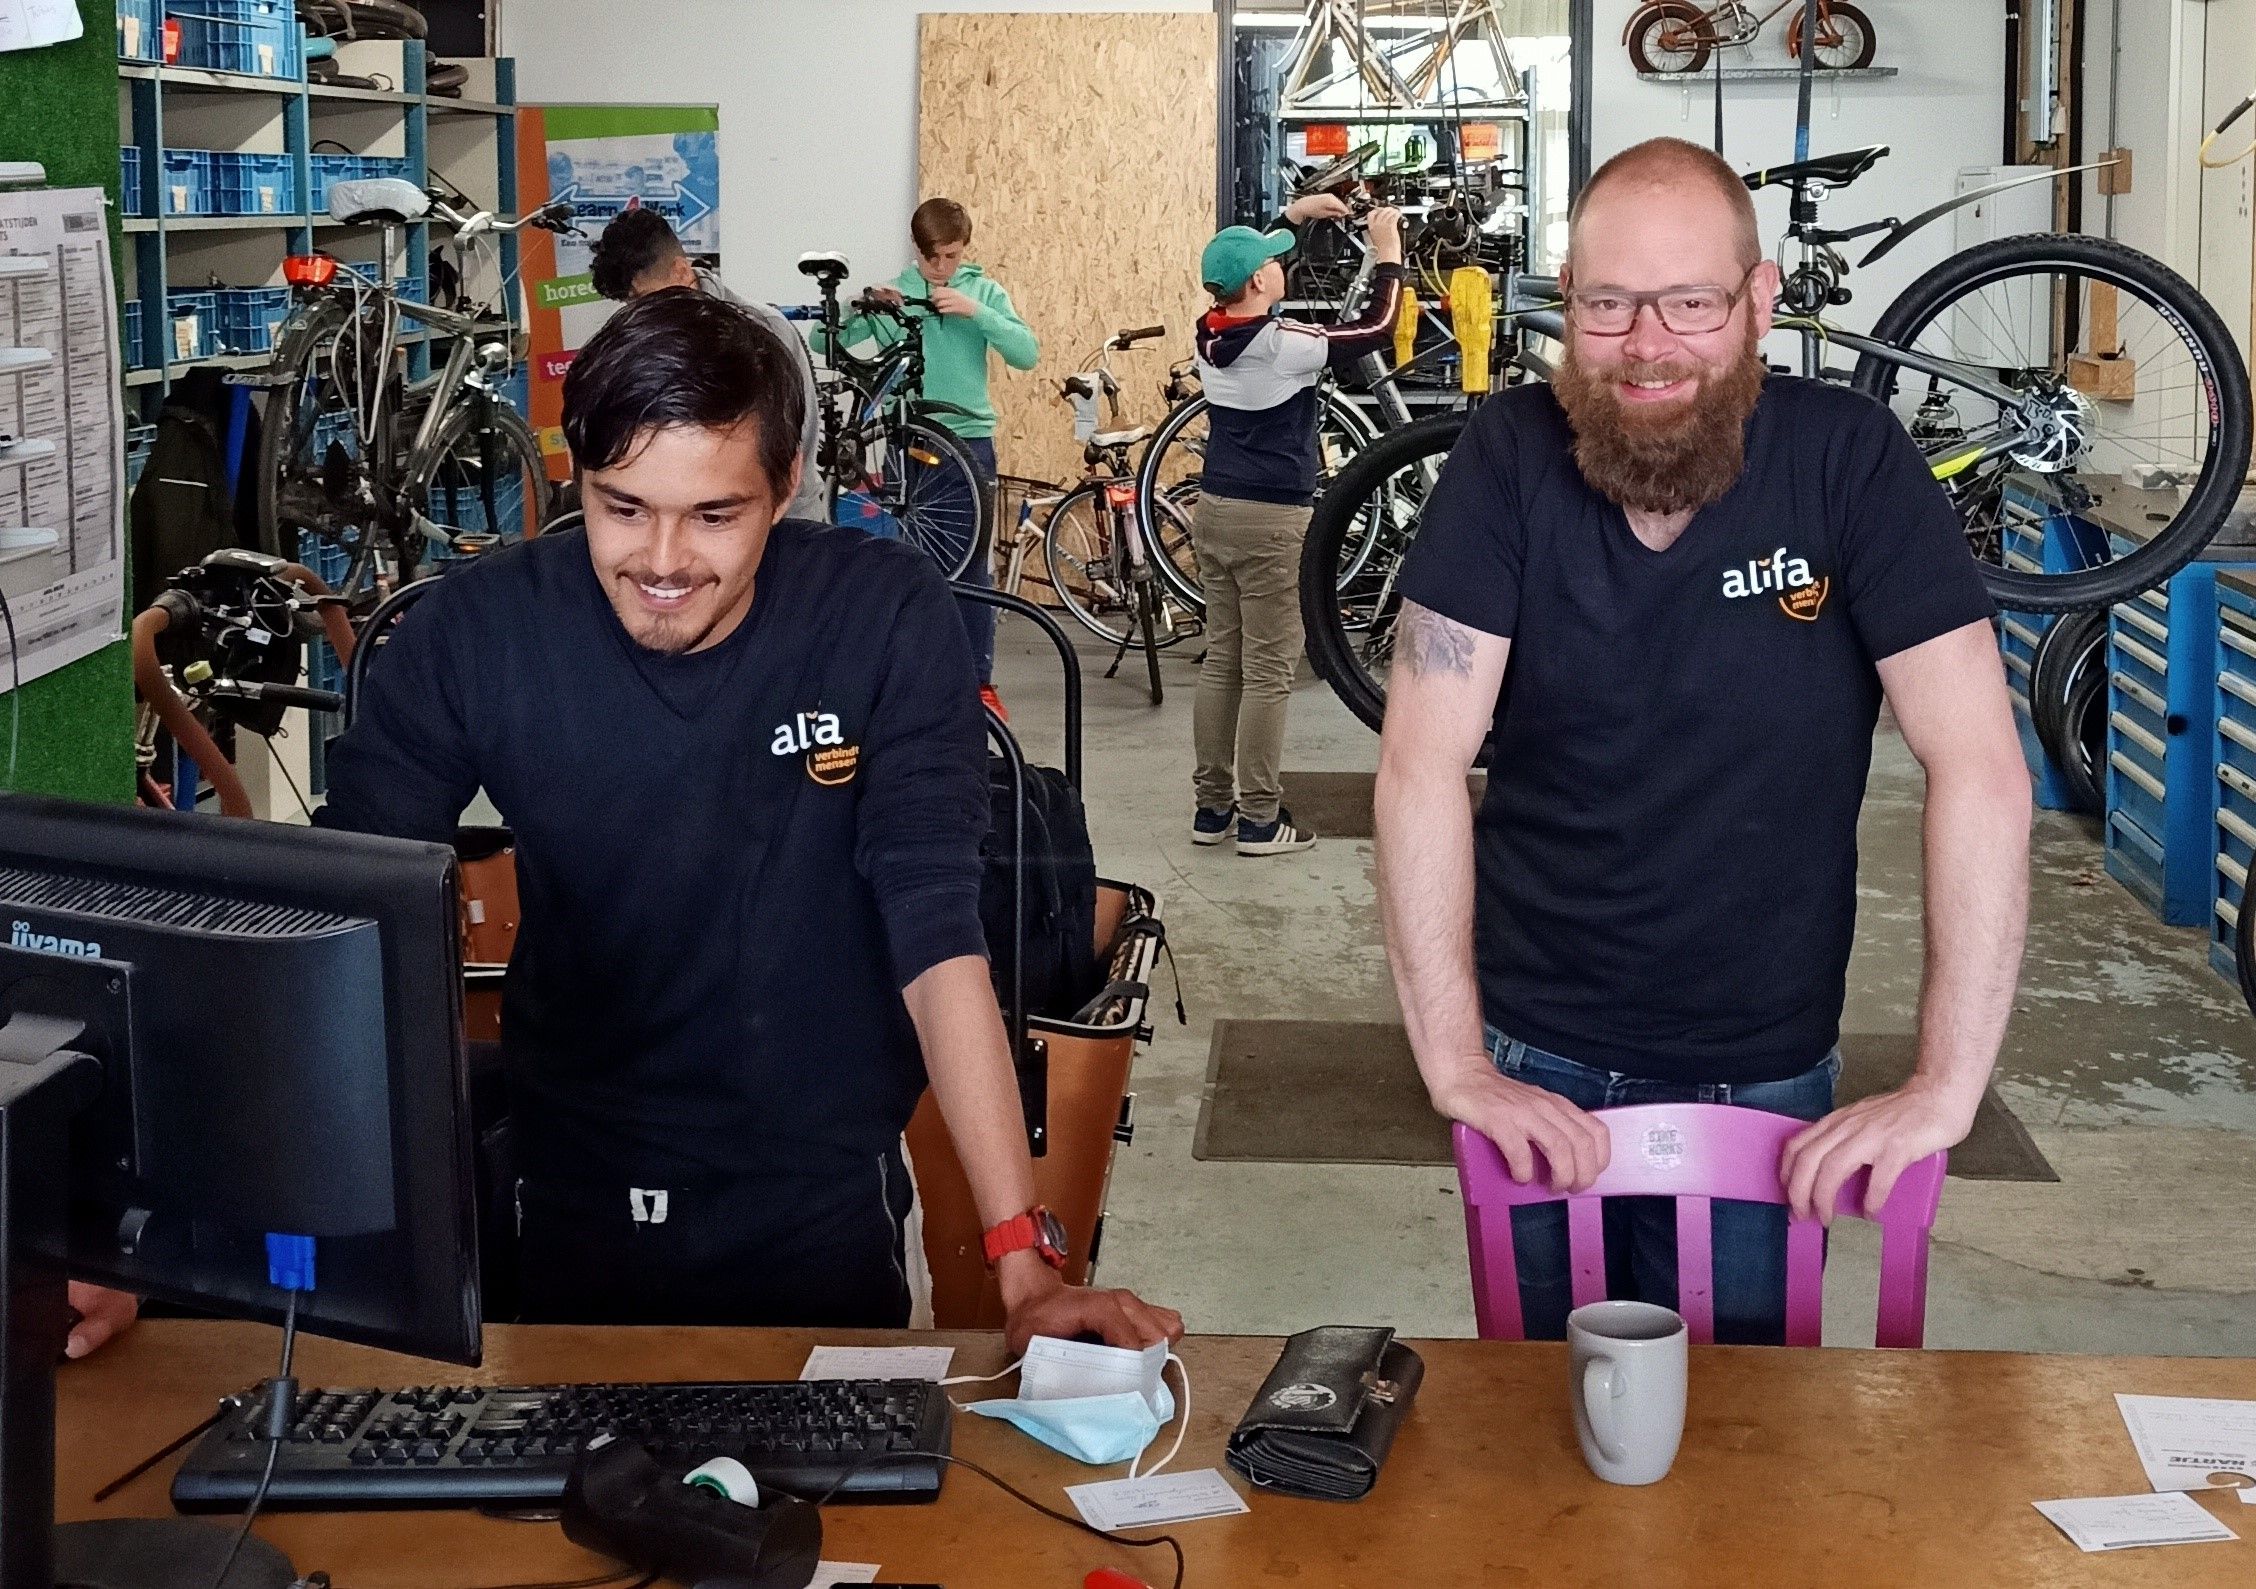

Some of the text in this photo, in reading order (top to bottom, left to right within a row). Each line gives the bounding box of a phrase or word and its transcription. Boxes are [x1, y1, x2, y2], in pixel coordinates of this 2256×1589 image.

[1722, 547, 1814, 598] alifa
[815, 745, 860, 762] verbindt
[815, 757, 857, 772] mensen
[11, 920, 101, 959] iiyama
